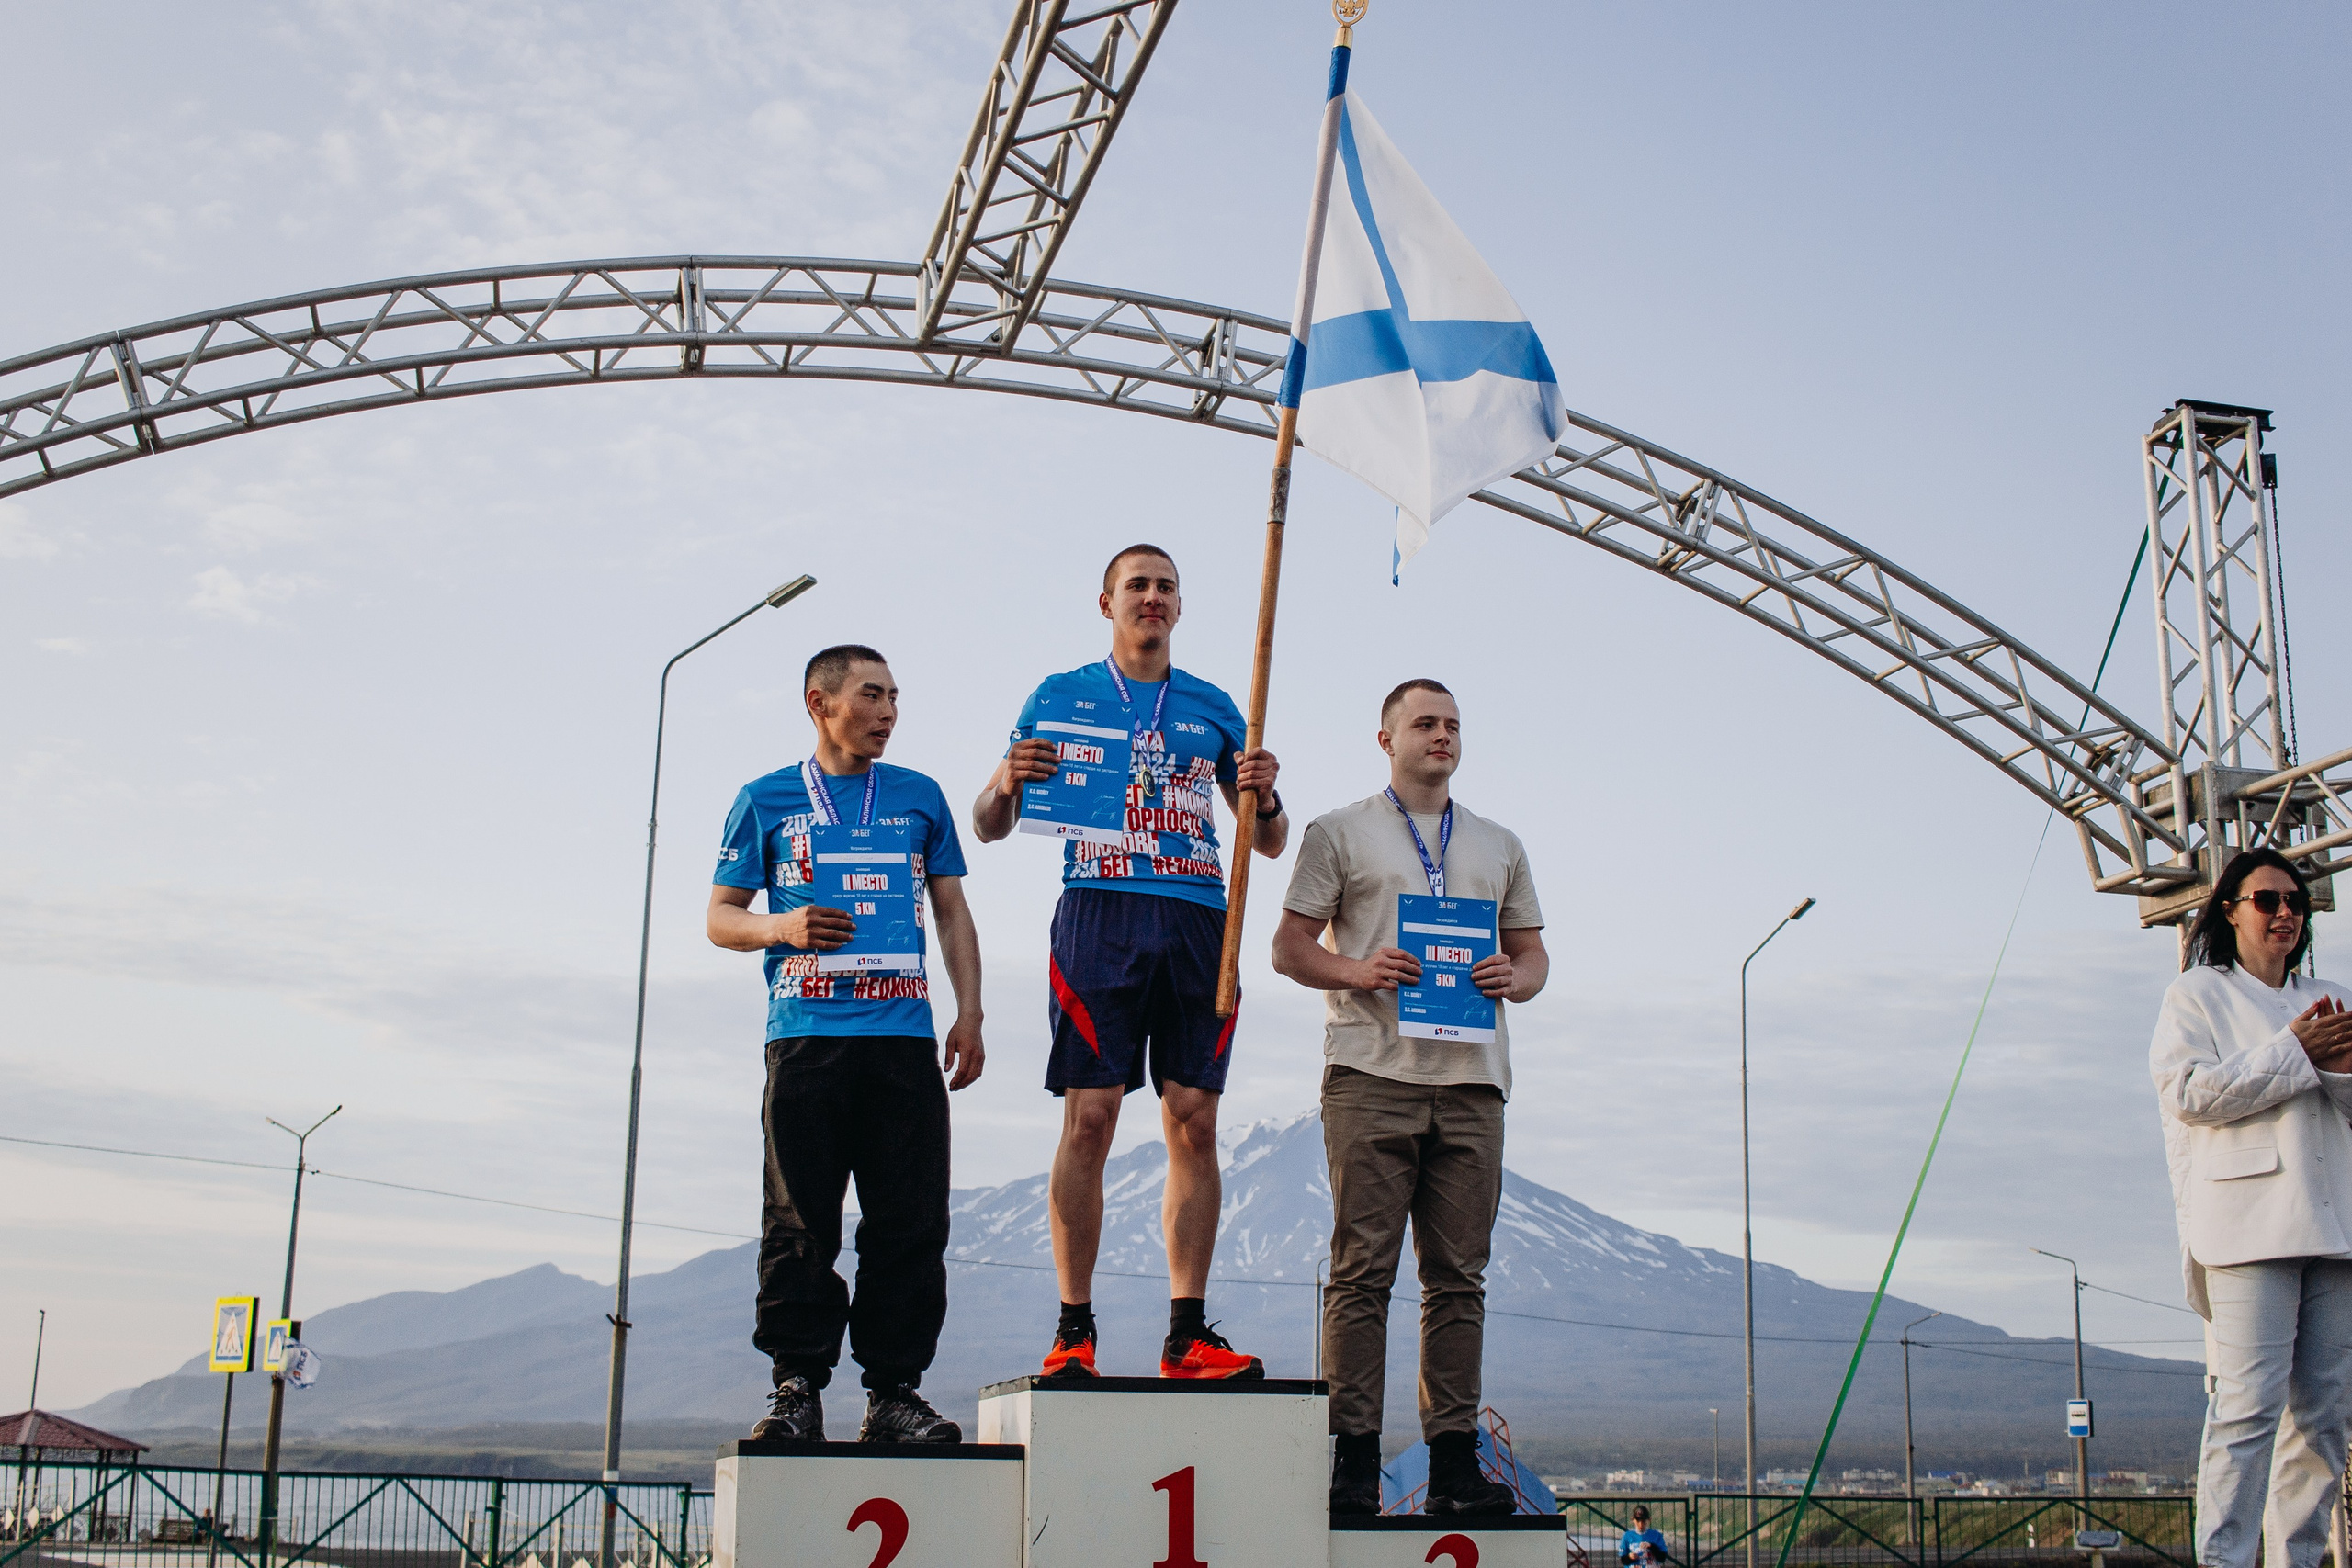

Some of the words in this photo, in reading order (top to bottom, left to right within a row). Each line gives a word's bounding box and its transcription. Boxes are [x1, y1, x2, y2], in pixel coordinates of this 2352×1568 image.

[1063, 743, 1104, 765] МЕСТО
[1065, 772, 1072, 785] 5
[1072, 773, 1087, 786] КМ
[811, 763, 831, 804] САХАЛИНСКАЯ
[827, 804, 841, 825] ОБЛАС
[862, 788, 873, 825] ХАЛИНСКАЯ
[1125, 807, 1205, 840] ОРДОСТЬ
[852, 874, 888, 891] МЕСТО
[854, 902, 861, 915] 5
[863, 902, 876, 915] КМ
[1436, 946, 1473, 964] МЕСТО
[1435, 974, 1442, 987] 5
[1442, 974, 1456, 987] КМ
[1151, 1466, 1208, 1568] 1
[846, 1497, 910, 1568] 2
